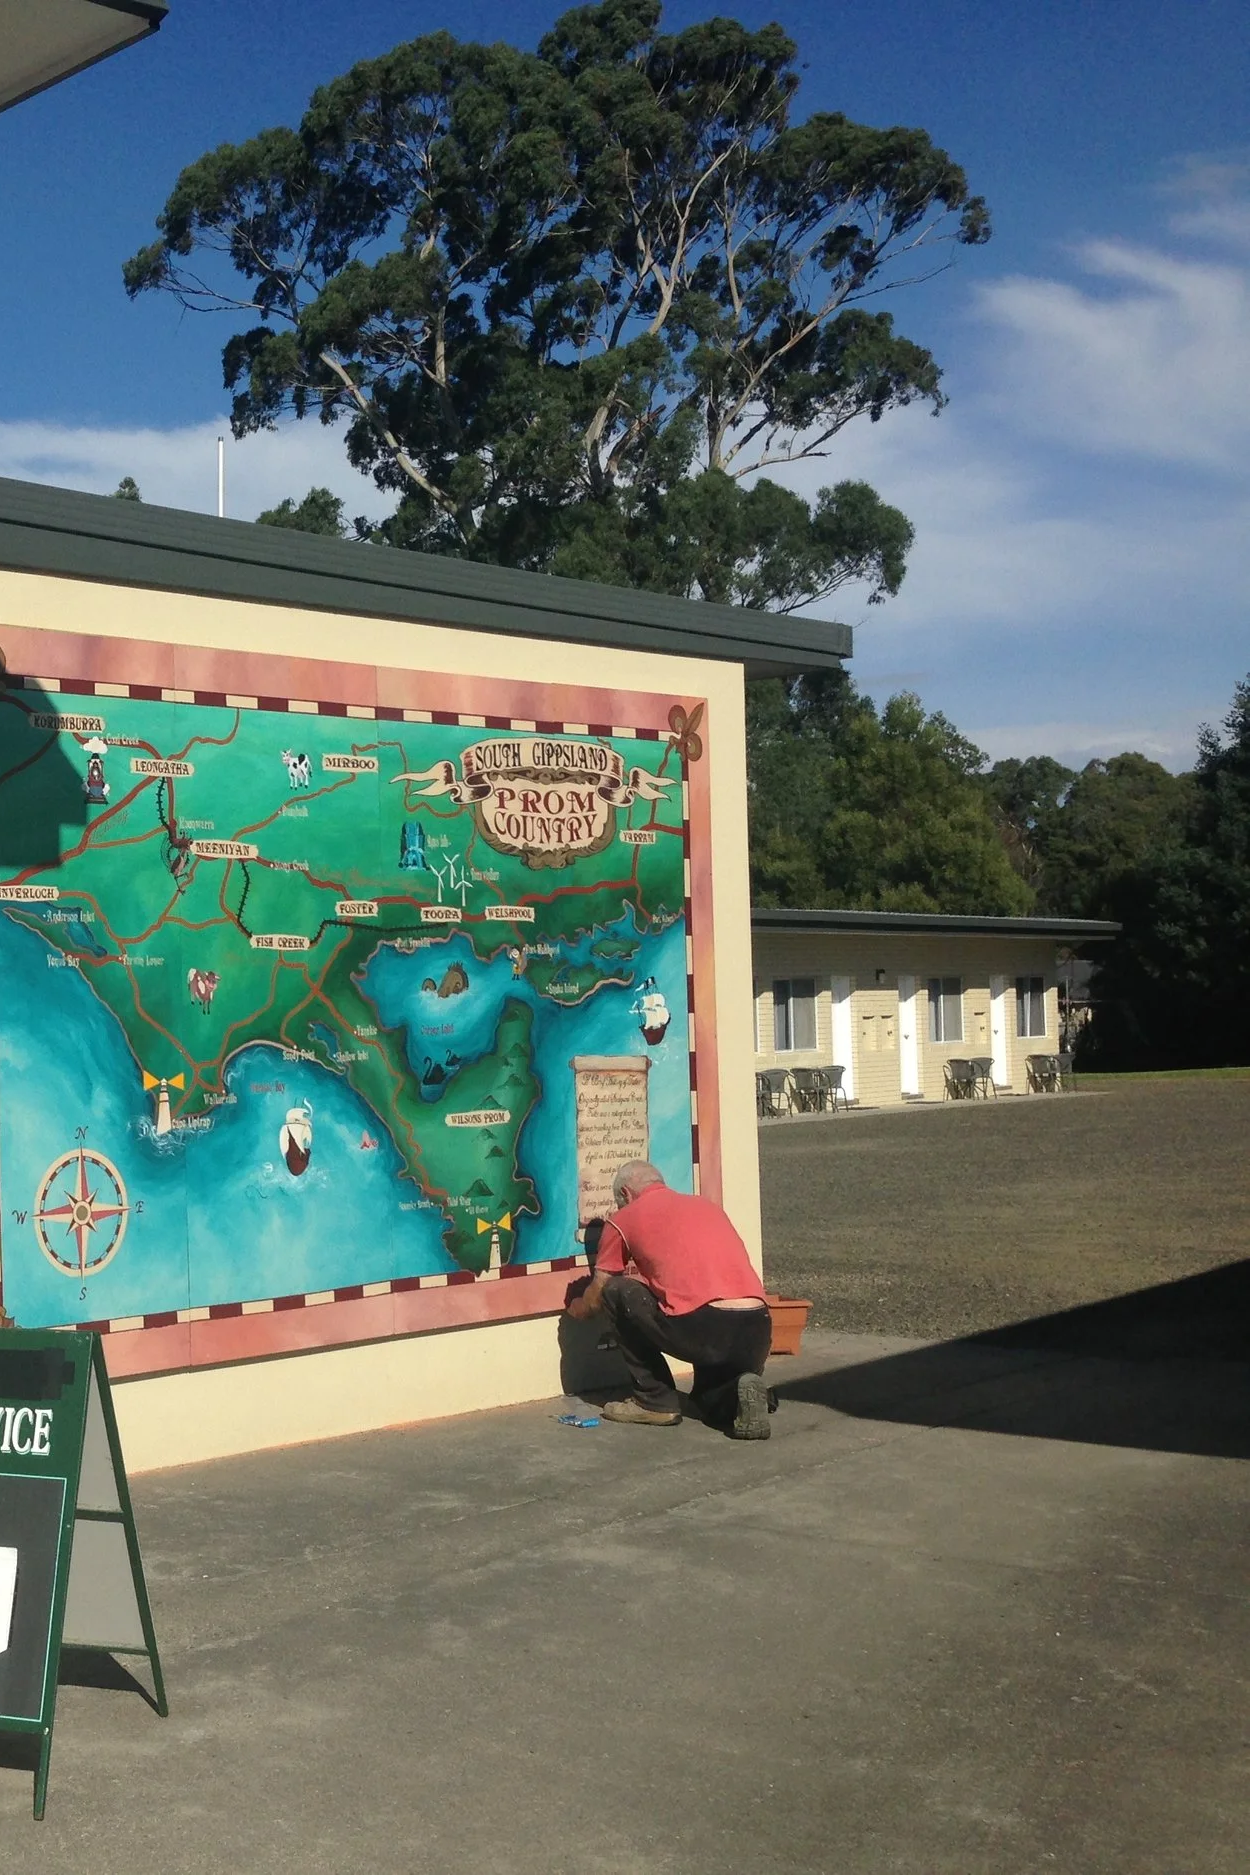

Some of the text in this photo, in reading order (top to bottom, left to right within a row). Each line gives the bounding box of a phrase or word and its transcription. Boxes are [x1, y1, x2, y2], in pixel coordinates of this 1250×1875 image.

[33, 716, 103, 731] KORUMBURRA
[325, 757, 376, 770] MIRBOO
[474, 741, 609, 772] SOUTH GIPPSLAND
[134, 761, 190, 776] LEONGATHA
[493, 788, 597, 815] PROM
[493, 811, 598, 844] COUNTRY
[195, 842, 250, 856] MEENIYAN
[339, 904, 375, 915] FOSTER
[423, 910, 460, 920] TOORA
[487, 908, 532, 920] WELSHPOOL
[255, 937, 305, 948] FISH CREEK
[450, 1112, 505, 1125] WILSONS PROM
[75, 1125, 89, 1140] N
[135, 1201, 144, 1214] E
[12, 1209, 28, 1225] W
[78, 1286, 87, 1301] S
